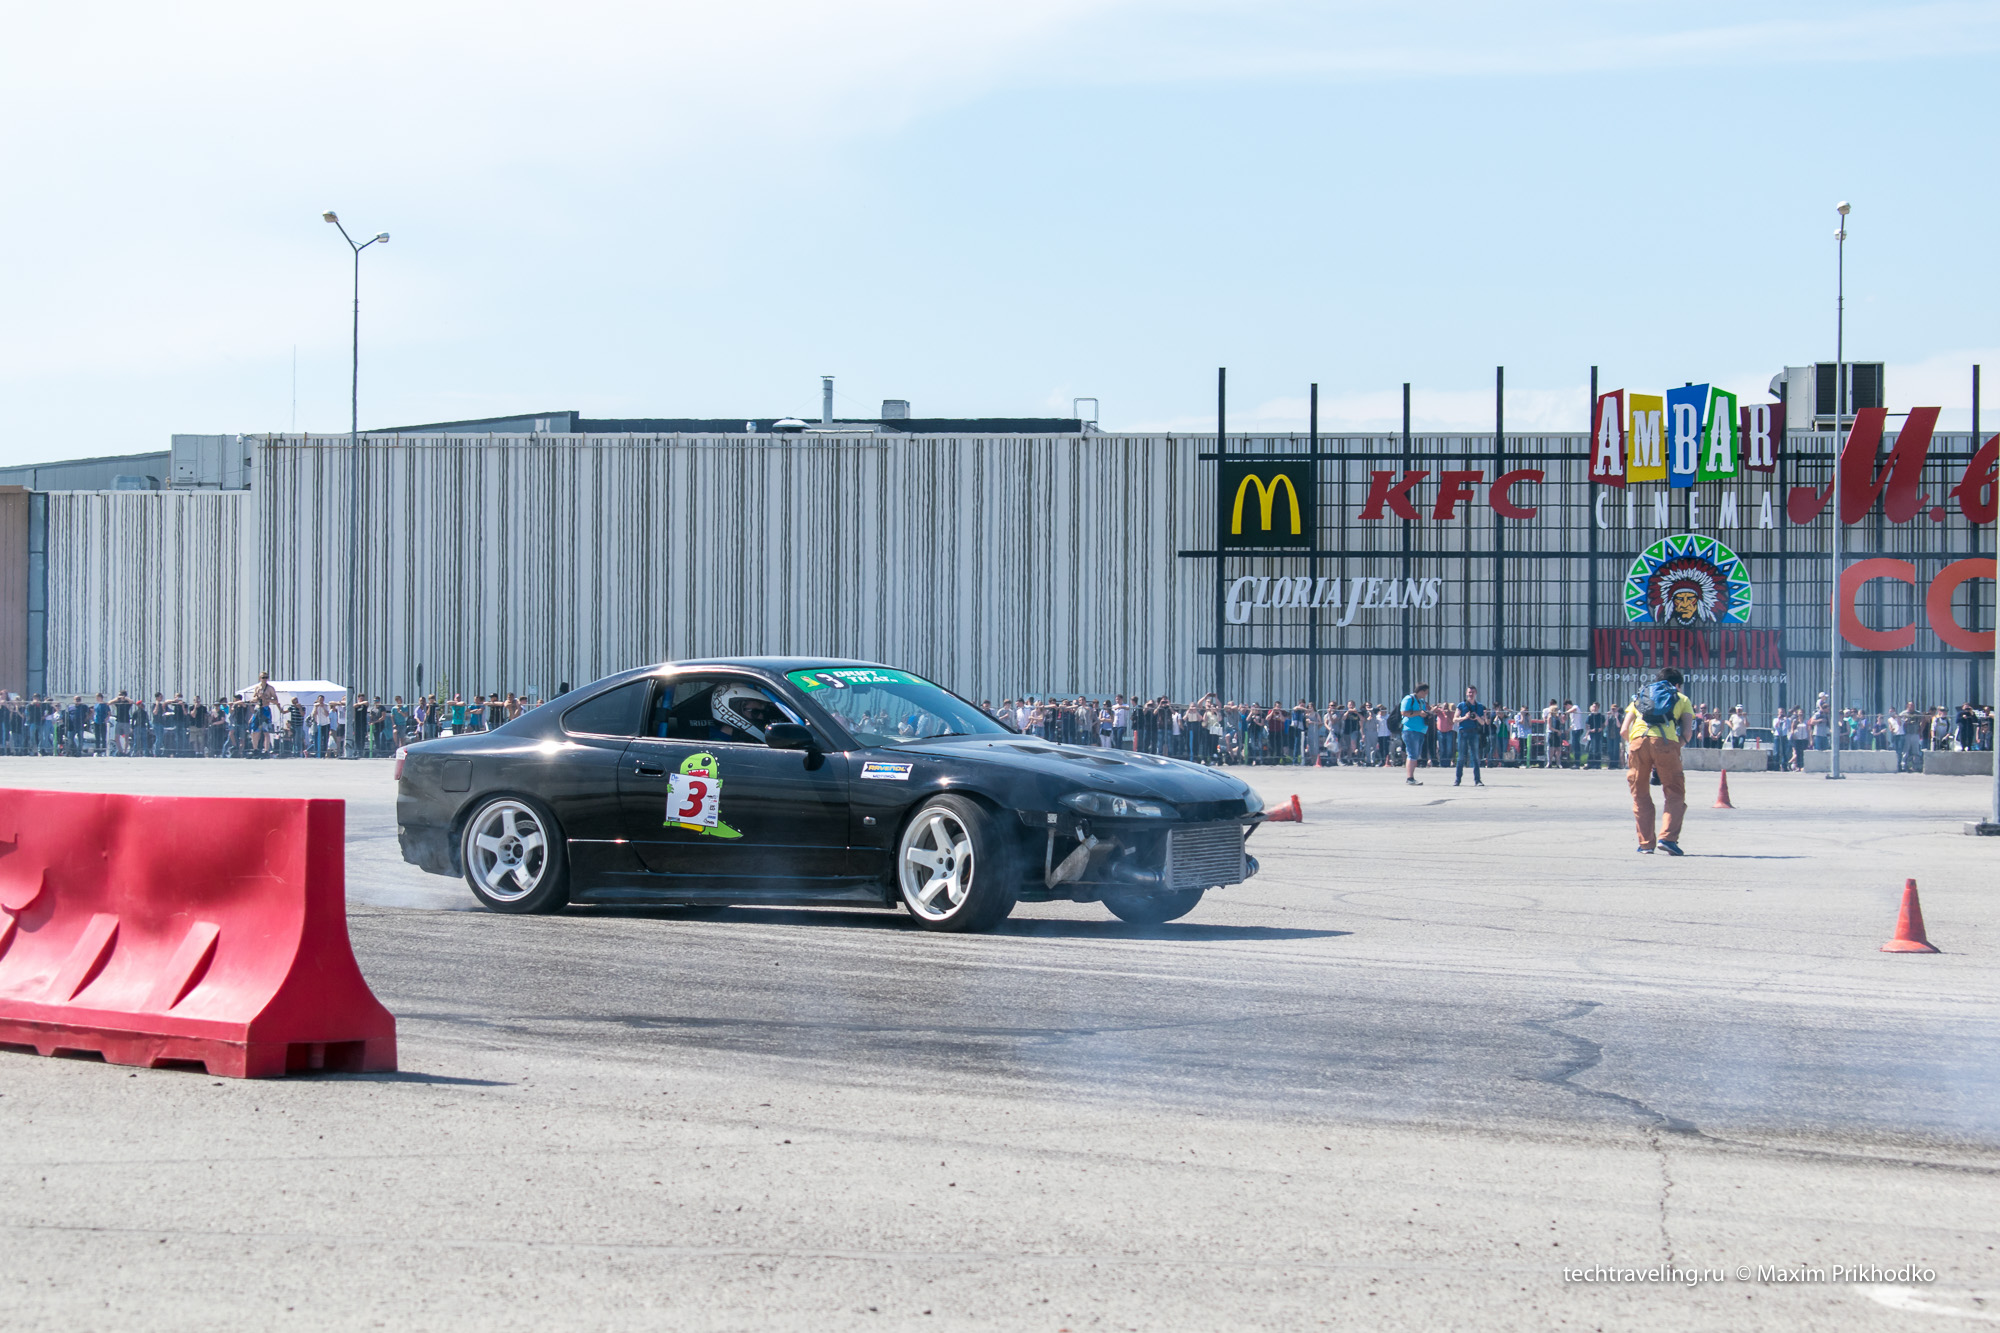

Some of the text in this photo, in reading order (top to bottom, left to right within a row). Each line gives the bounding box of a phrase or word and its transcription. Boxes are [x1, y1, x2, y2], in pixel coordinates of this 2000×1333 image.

[1593, 396, 1775, 476] AMBAR
[1357, 469, 1545, 520] KFC
[1595, 491, 1774, 530] CINEMA
[1225, 576, 1442, 627] GLORIA JEANS
[1593, 628, 1782, 670] WESTERN PARK
[1588, 673, 1788, 684] ТЕРРИТОР ПРИКЛЮЧЕНИЙ
[868, 764, 906, 772] RAVENOL
[678, 780, 708, 818] 3
